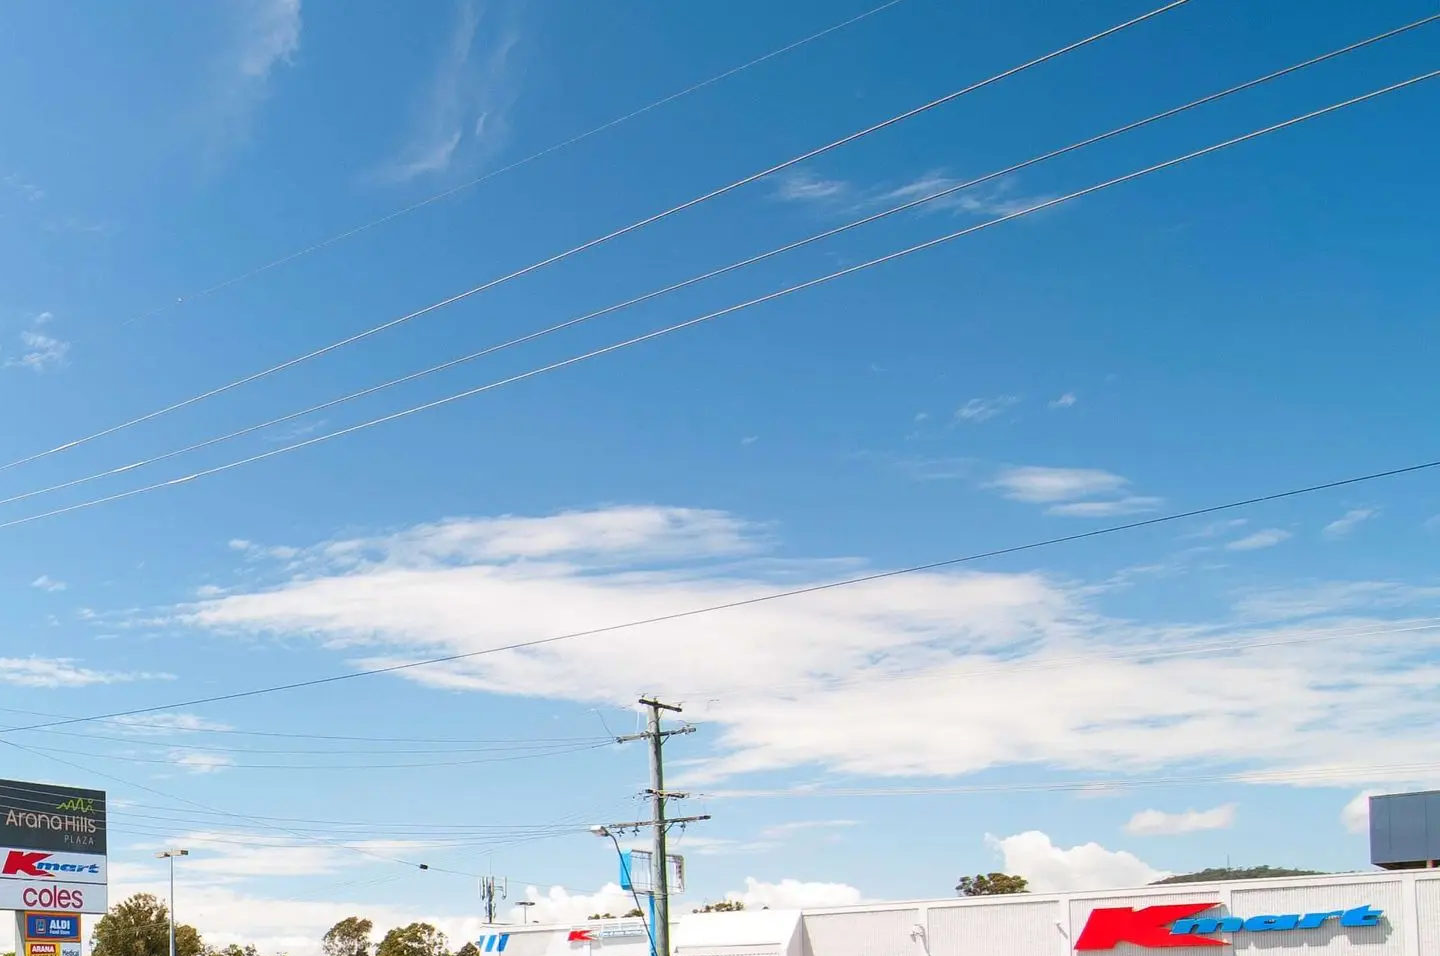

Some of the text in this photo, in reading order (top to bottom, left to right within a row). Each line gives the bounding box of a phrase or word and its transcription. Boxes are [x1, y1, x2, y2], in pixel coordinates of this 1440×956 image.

[5, 809, 96, 833] Arana Hills
[64, 834, 94, 845] PLAZA
[2, 850, 100, 877] Kmart
[23, 885, 83, 909] coles
[49, 920, 71, 930] ALDI
[1073, 902, 1384, 950] Kmart
